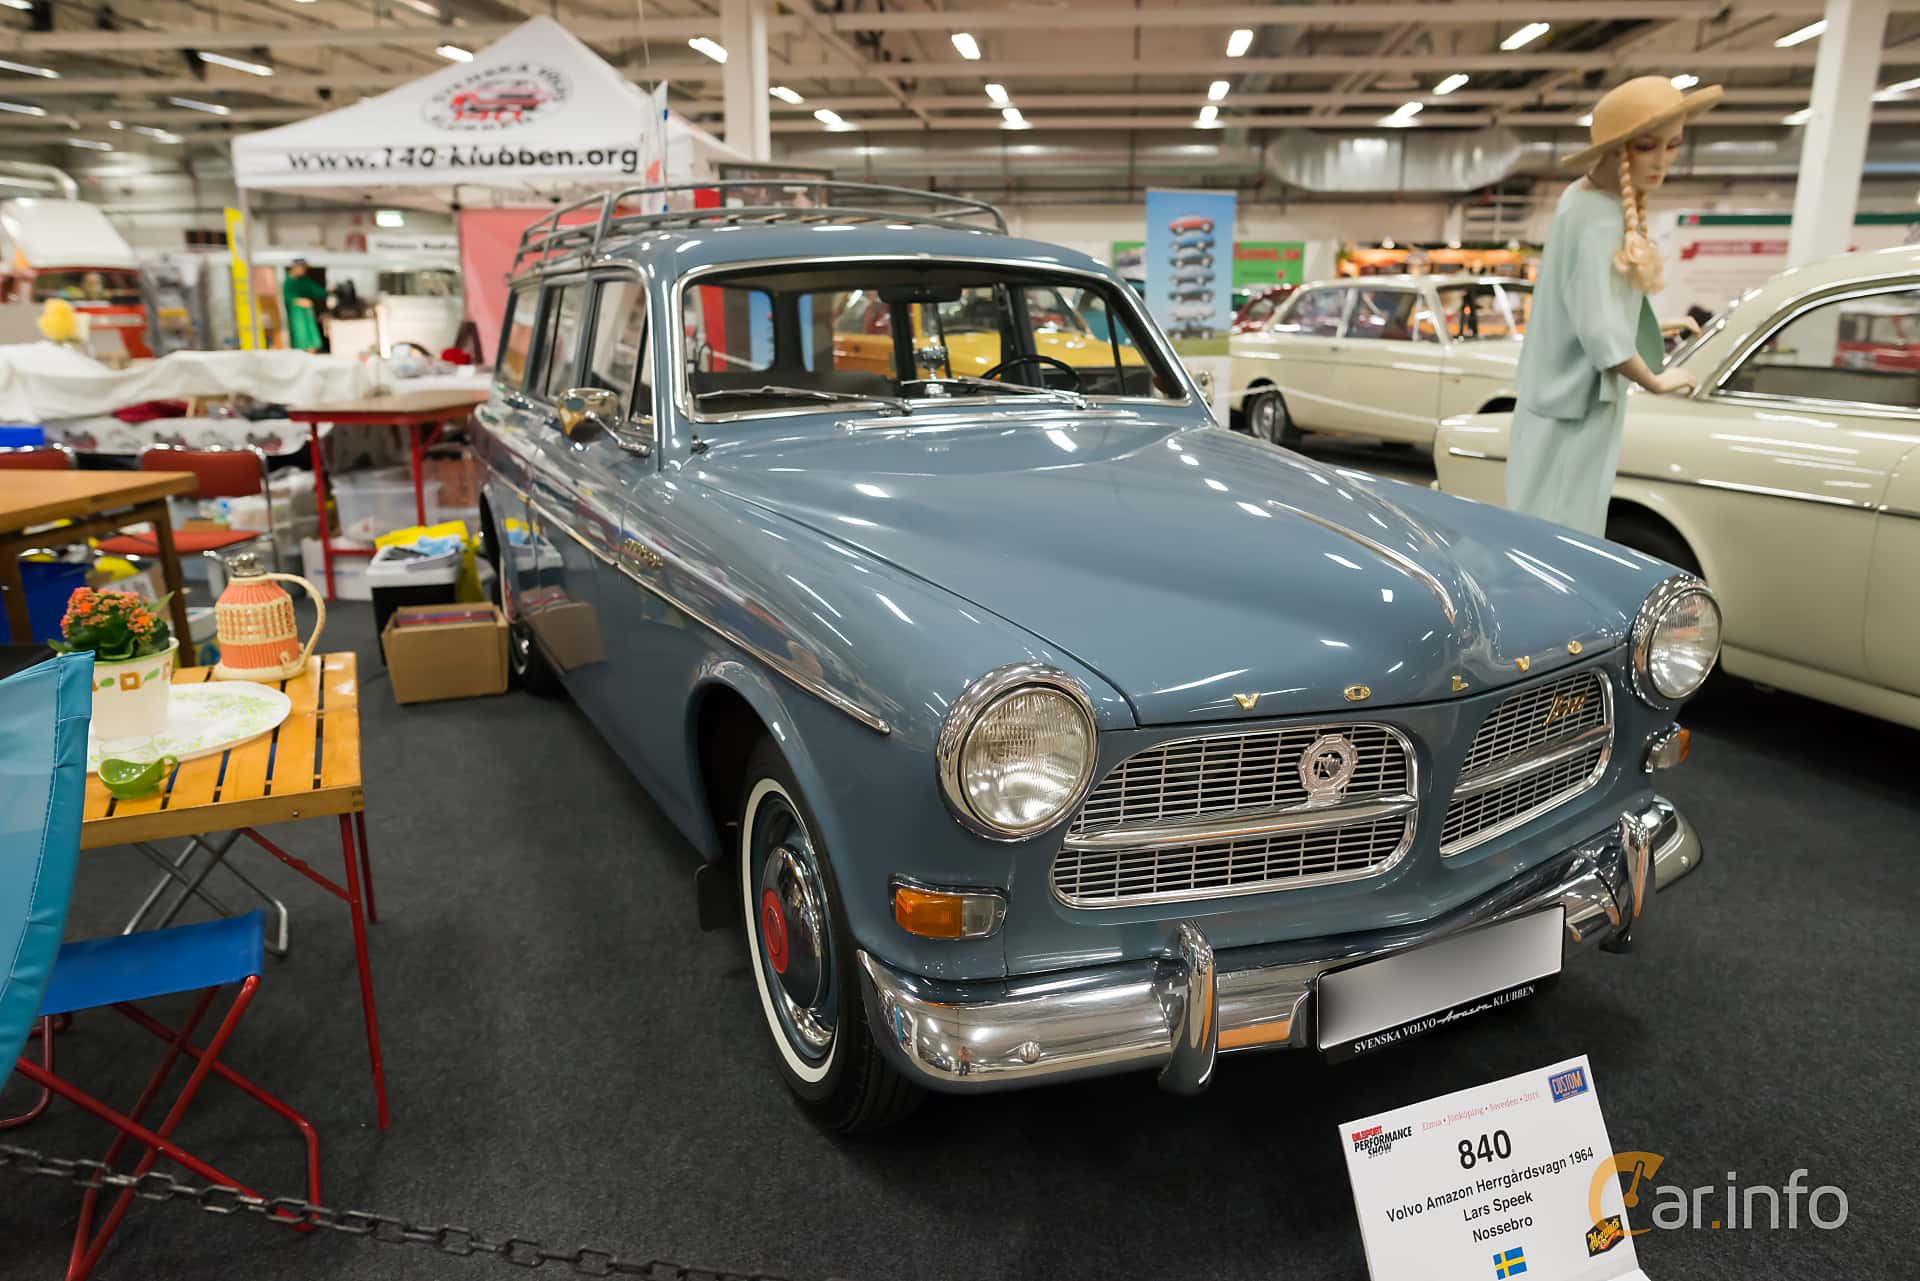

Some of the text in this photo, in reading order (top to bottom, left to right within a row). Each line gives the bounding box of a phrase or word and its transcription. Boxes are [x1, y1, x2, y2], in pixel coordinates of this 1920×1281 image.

[1354, 1030, 1401, 1054] SVENSKA
[1402, 1018, 1436, 1037] VOLVO
[1493, 984, 1535, 1008] KLUBBEN
[1551, 1070, 1583, 1095] CUSTOM
[1354, 1126, 1412, 1152] PERFORMANCE
[1367, 1143, 1392, 1156] SHOW
[1458, 1129, 1512, 1170] 840
[1386, 1146, 1594, 1223] Volvo Amazon Herrgårdsvagn 1964
[1463, 1190, 1534, 1222] Lars Speek
[1472, 1217, 1534, 1243] Nossebro
